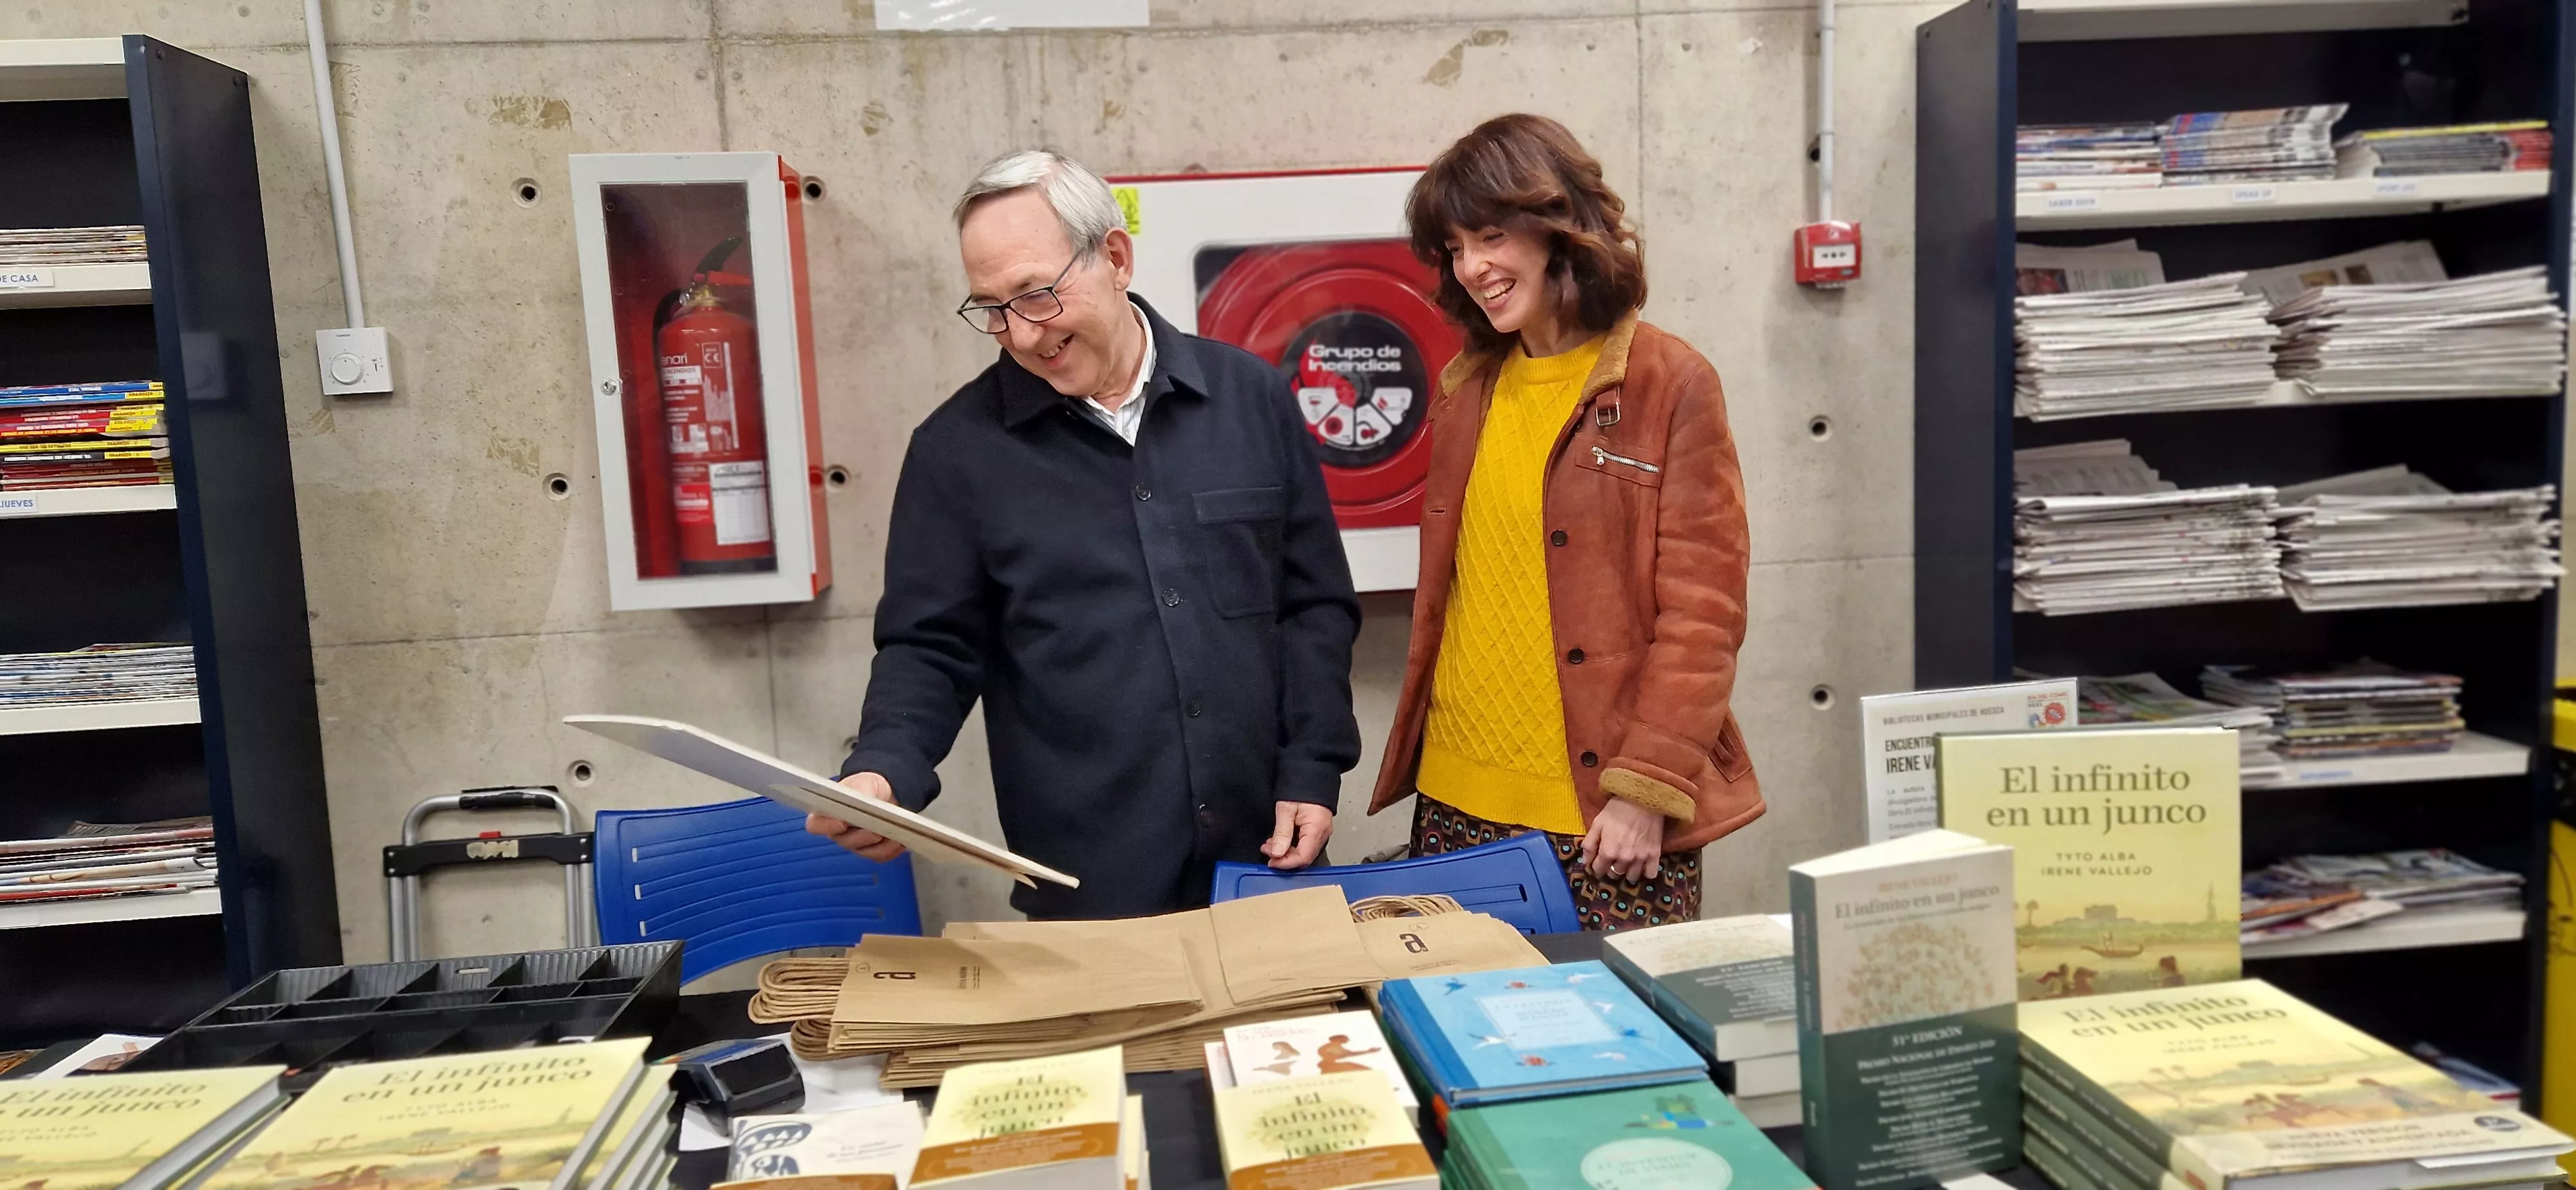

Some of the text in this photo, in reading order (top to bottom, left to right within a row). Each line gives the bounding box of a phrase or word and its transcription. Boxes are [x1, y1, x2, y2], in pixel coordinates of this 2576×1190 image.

[1309, 345, 1401, 361] Grupo de
[1308, 360, 1402, 372] Incendios
[0, 500, 33, 508] JUEVES
[1883, 715, 1924, 726] BIBLIOTECAS
[1926, 711, 1968, 721] MUNICIPALES
[1970, 709, 1978, 717] DE
[1886, 736, 1935, 752] ENCUENTR
[1886, 757, 1920, 773] IRENE
[2000, 764, 2190, 794] El infinito
[1986, 798, 2206, 835] en un junco
[2056, 852, 2137, 862] TYTO ALBA
[2041, 865, 2153, 876] IRENE VALLEJO
[1835, 902, 1851, 919] El
[1855, 897, 1911, 917] infinito
[1913, 894, 1933, 908] en
[1935, 891, 1956, 904] un
[1956, 885, 2000, 905] junco
[1399, 933, 1429, 954] a
[2063, 997, 2248, 1023] El infinito
[2071, 1008, 2287, 1037] en un junco
[377, 1057, 587, 1085] El infinito
[54, 1082, 207, 1102] infinito
[343, 1069, 592, 1103] en un junco
[973, 1086, 1082, 1107] infinito
[15, 1099, 201, 1119] un junco
[980, 1100, 1064, 1119] en un
[1260, 1106, 1367, 1128] infinito
[1278, 1122, 1358, 1140] en un
